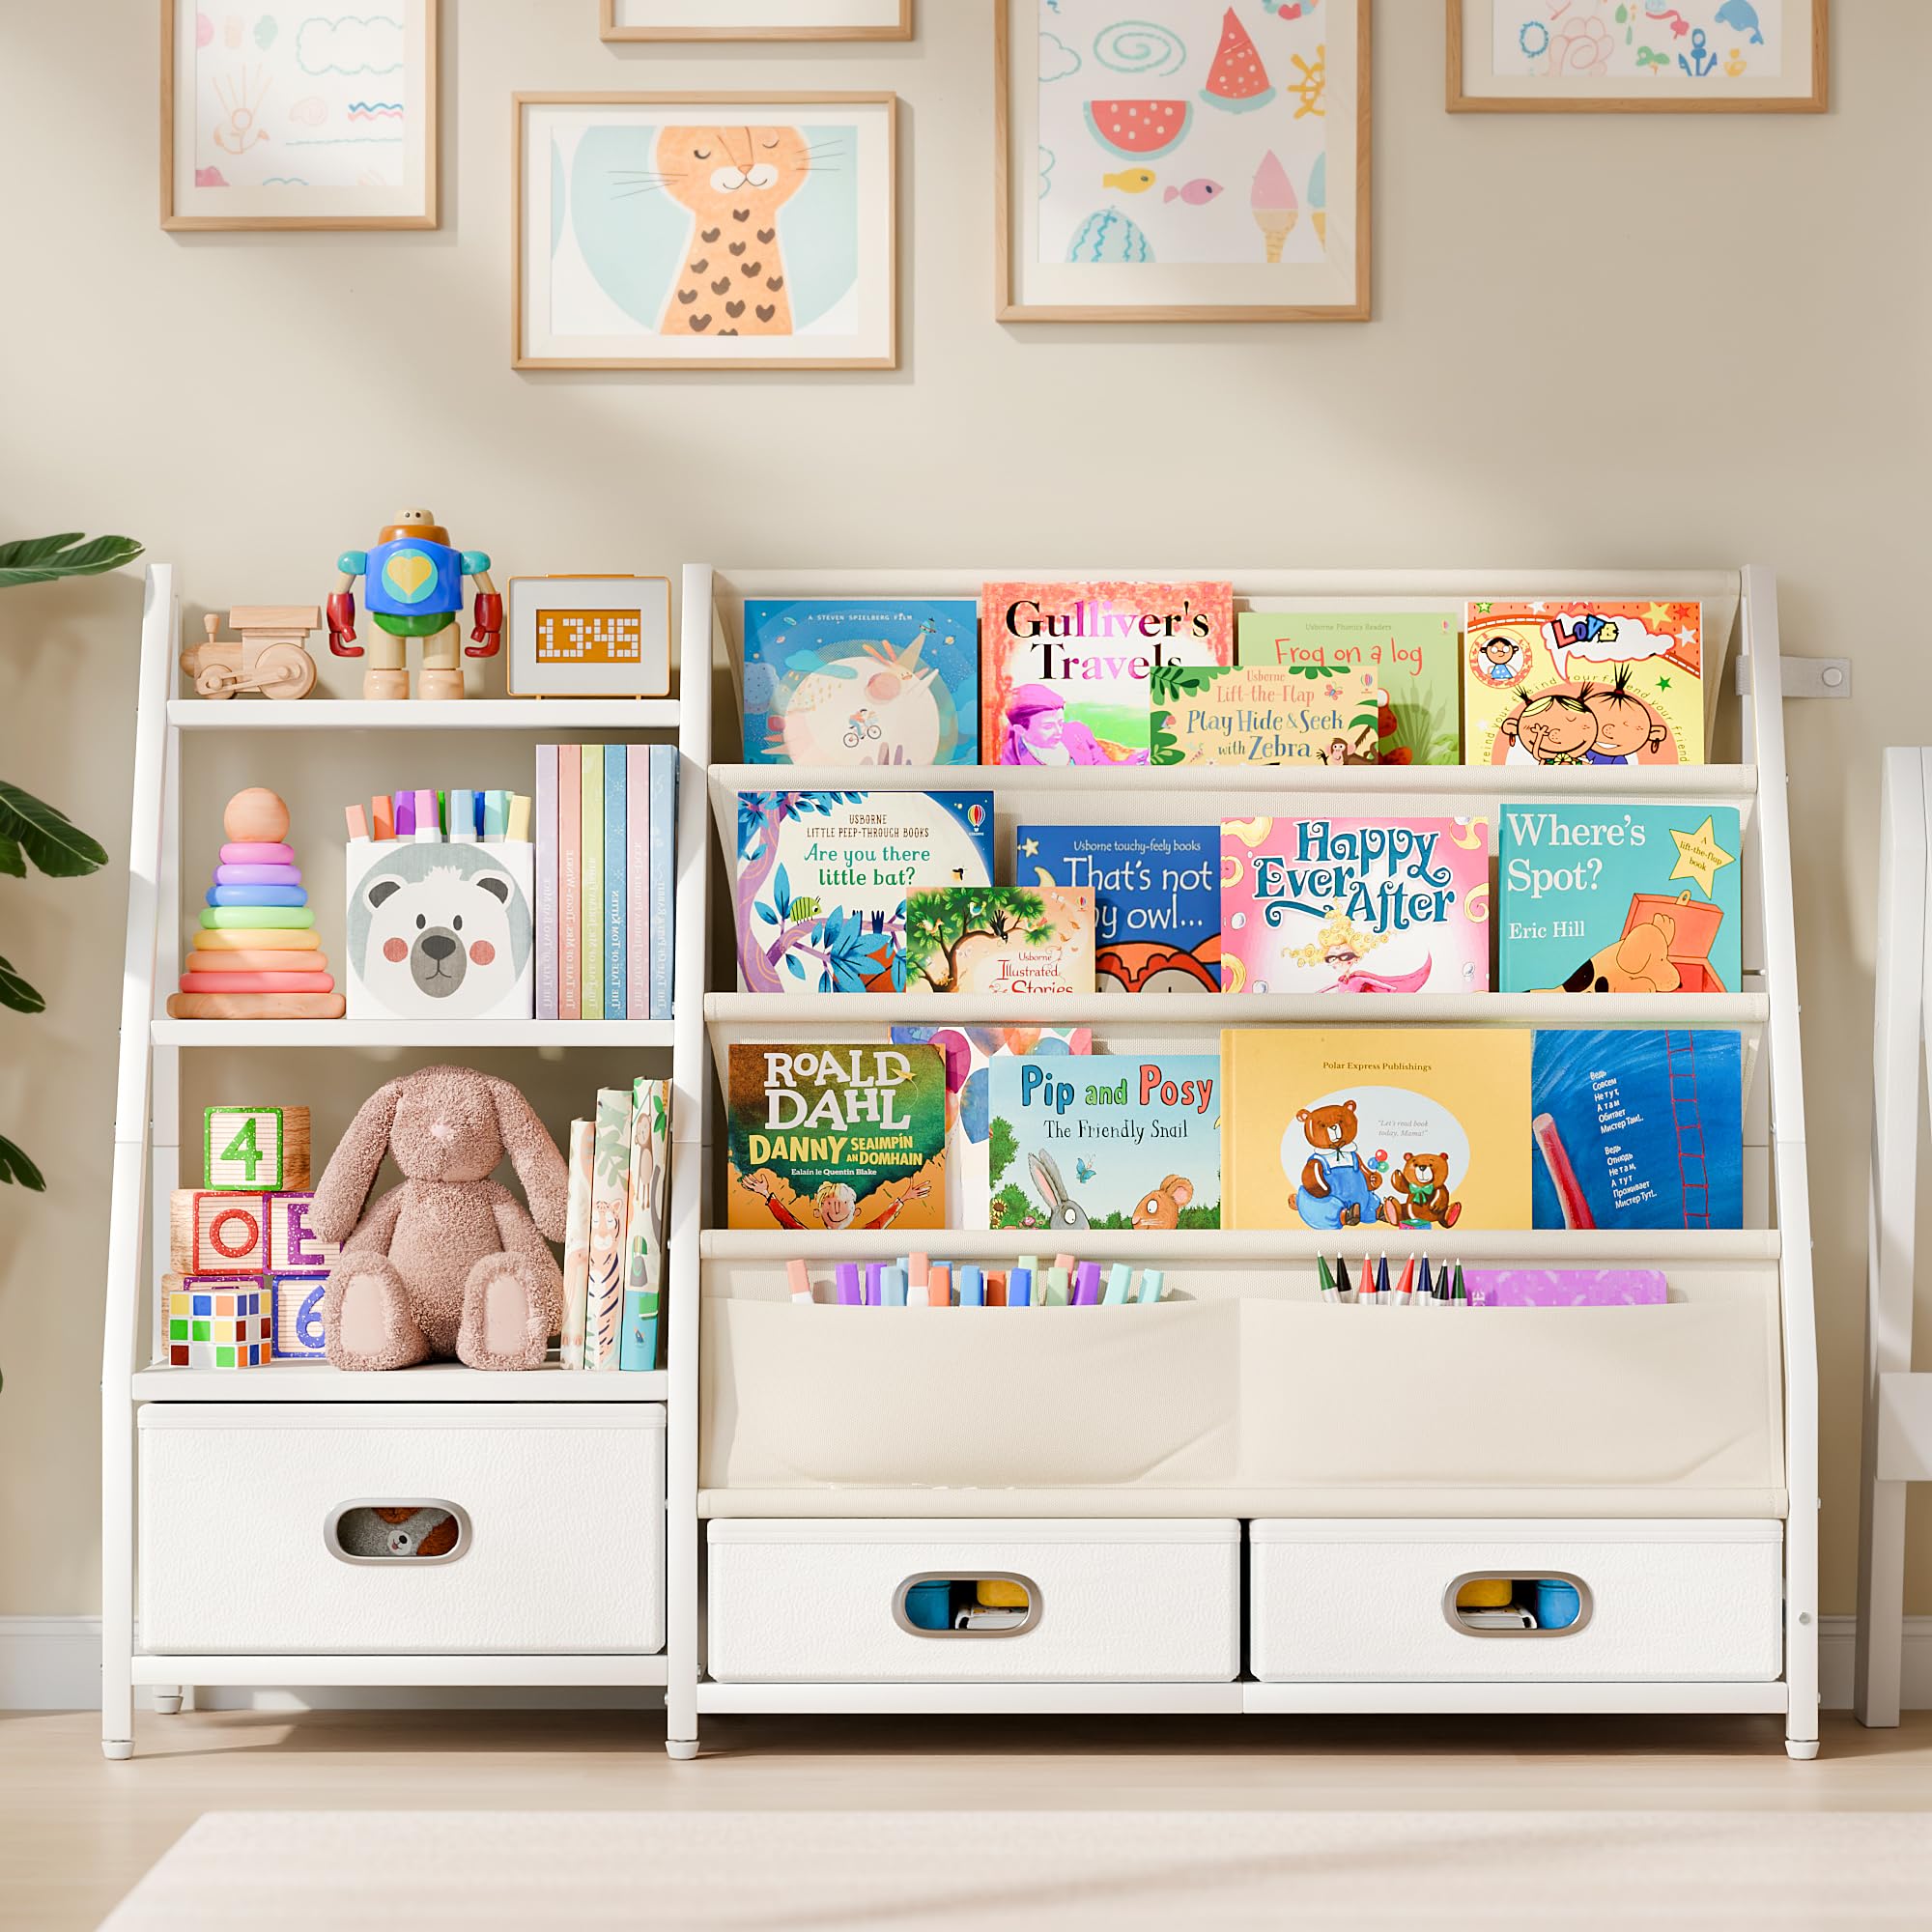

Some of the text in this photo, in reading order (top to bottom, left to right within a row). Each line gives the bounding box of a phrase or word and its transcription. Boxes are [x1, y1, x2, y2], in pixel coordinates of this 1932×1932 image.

[1006, 600, 1209, 638] Gulliver's
[539, 618, 638, 657] 13:45
[1334, 646, 1361, 664] on
[1371, 645, 1382, 665] a
[1391, 637, 1423, 676] log
[1247, 670, 1286, 682] Usborne
[1217, 685, 1315, 708] Lift-the-Flap
[1186, 709, 1344, 737] Play Hide & Seek
[1218, 734, 1312, 760] with Zebra
[807, 827, 930, 838] LITTLE PEEP-THROUGH BOOKS
[849, 814, 887, 825] USBORNE
[1506, 813, 1646, 847] Where's
[804, 842, 931, 867] Are you there
[1073, 838, 1201, 855] Usborne touchy-feely books
[1294, 821, 1452, 888] Happy
[818, 867, 916, 886] little bat?
[1063, 854, 1213, 892] That's not
[1689, 856, 1707, 871] book
[1254, 857, 1354, 899] Ever
[1507, 858, 1603, 899] Spot?
[1127, 893, 1203, 929] owl...
[1345, 880, 1456, 934] After
[1509, 921, 1585, 940] Eric Hill
[996, 959, 1058, 980] Illustrated
[1018, 952, 1052, 961] Usborne
[763, 1049, 911, 1088] ROALD
[1322, 1061, 1432, 1072] Polar Express Publishings
[1021, 1064, 1214, 1115] Pip and Posy
[1592, 1078, 1617, 1091] Совсем
[764, 1088, 911, 1132] DAHL
[1598, 1108, 1626, 1123] Обитает
[1043, 1119, 1188, 1146] The Friendly Snail
[1600, 1121, 1627, 1134] Мистер
[220, 1117, 263, 1181] 4
[749, 1132, 913, 1165] DANNY SEAIMPÍN
[846, 1151, 923, 1166] AN DOMHAIN
[823, 1168, 855, 1177] Quentin
[1615, 1195, 1641, 1209] Мистер
[287, 1203, 324, 1264] E
[296, 1285, 325, 1349] 6
